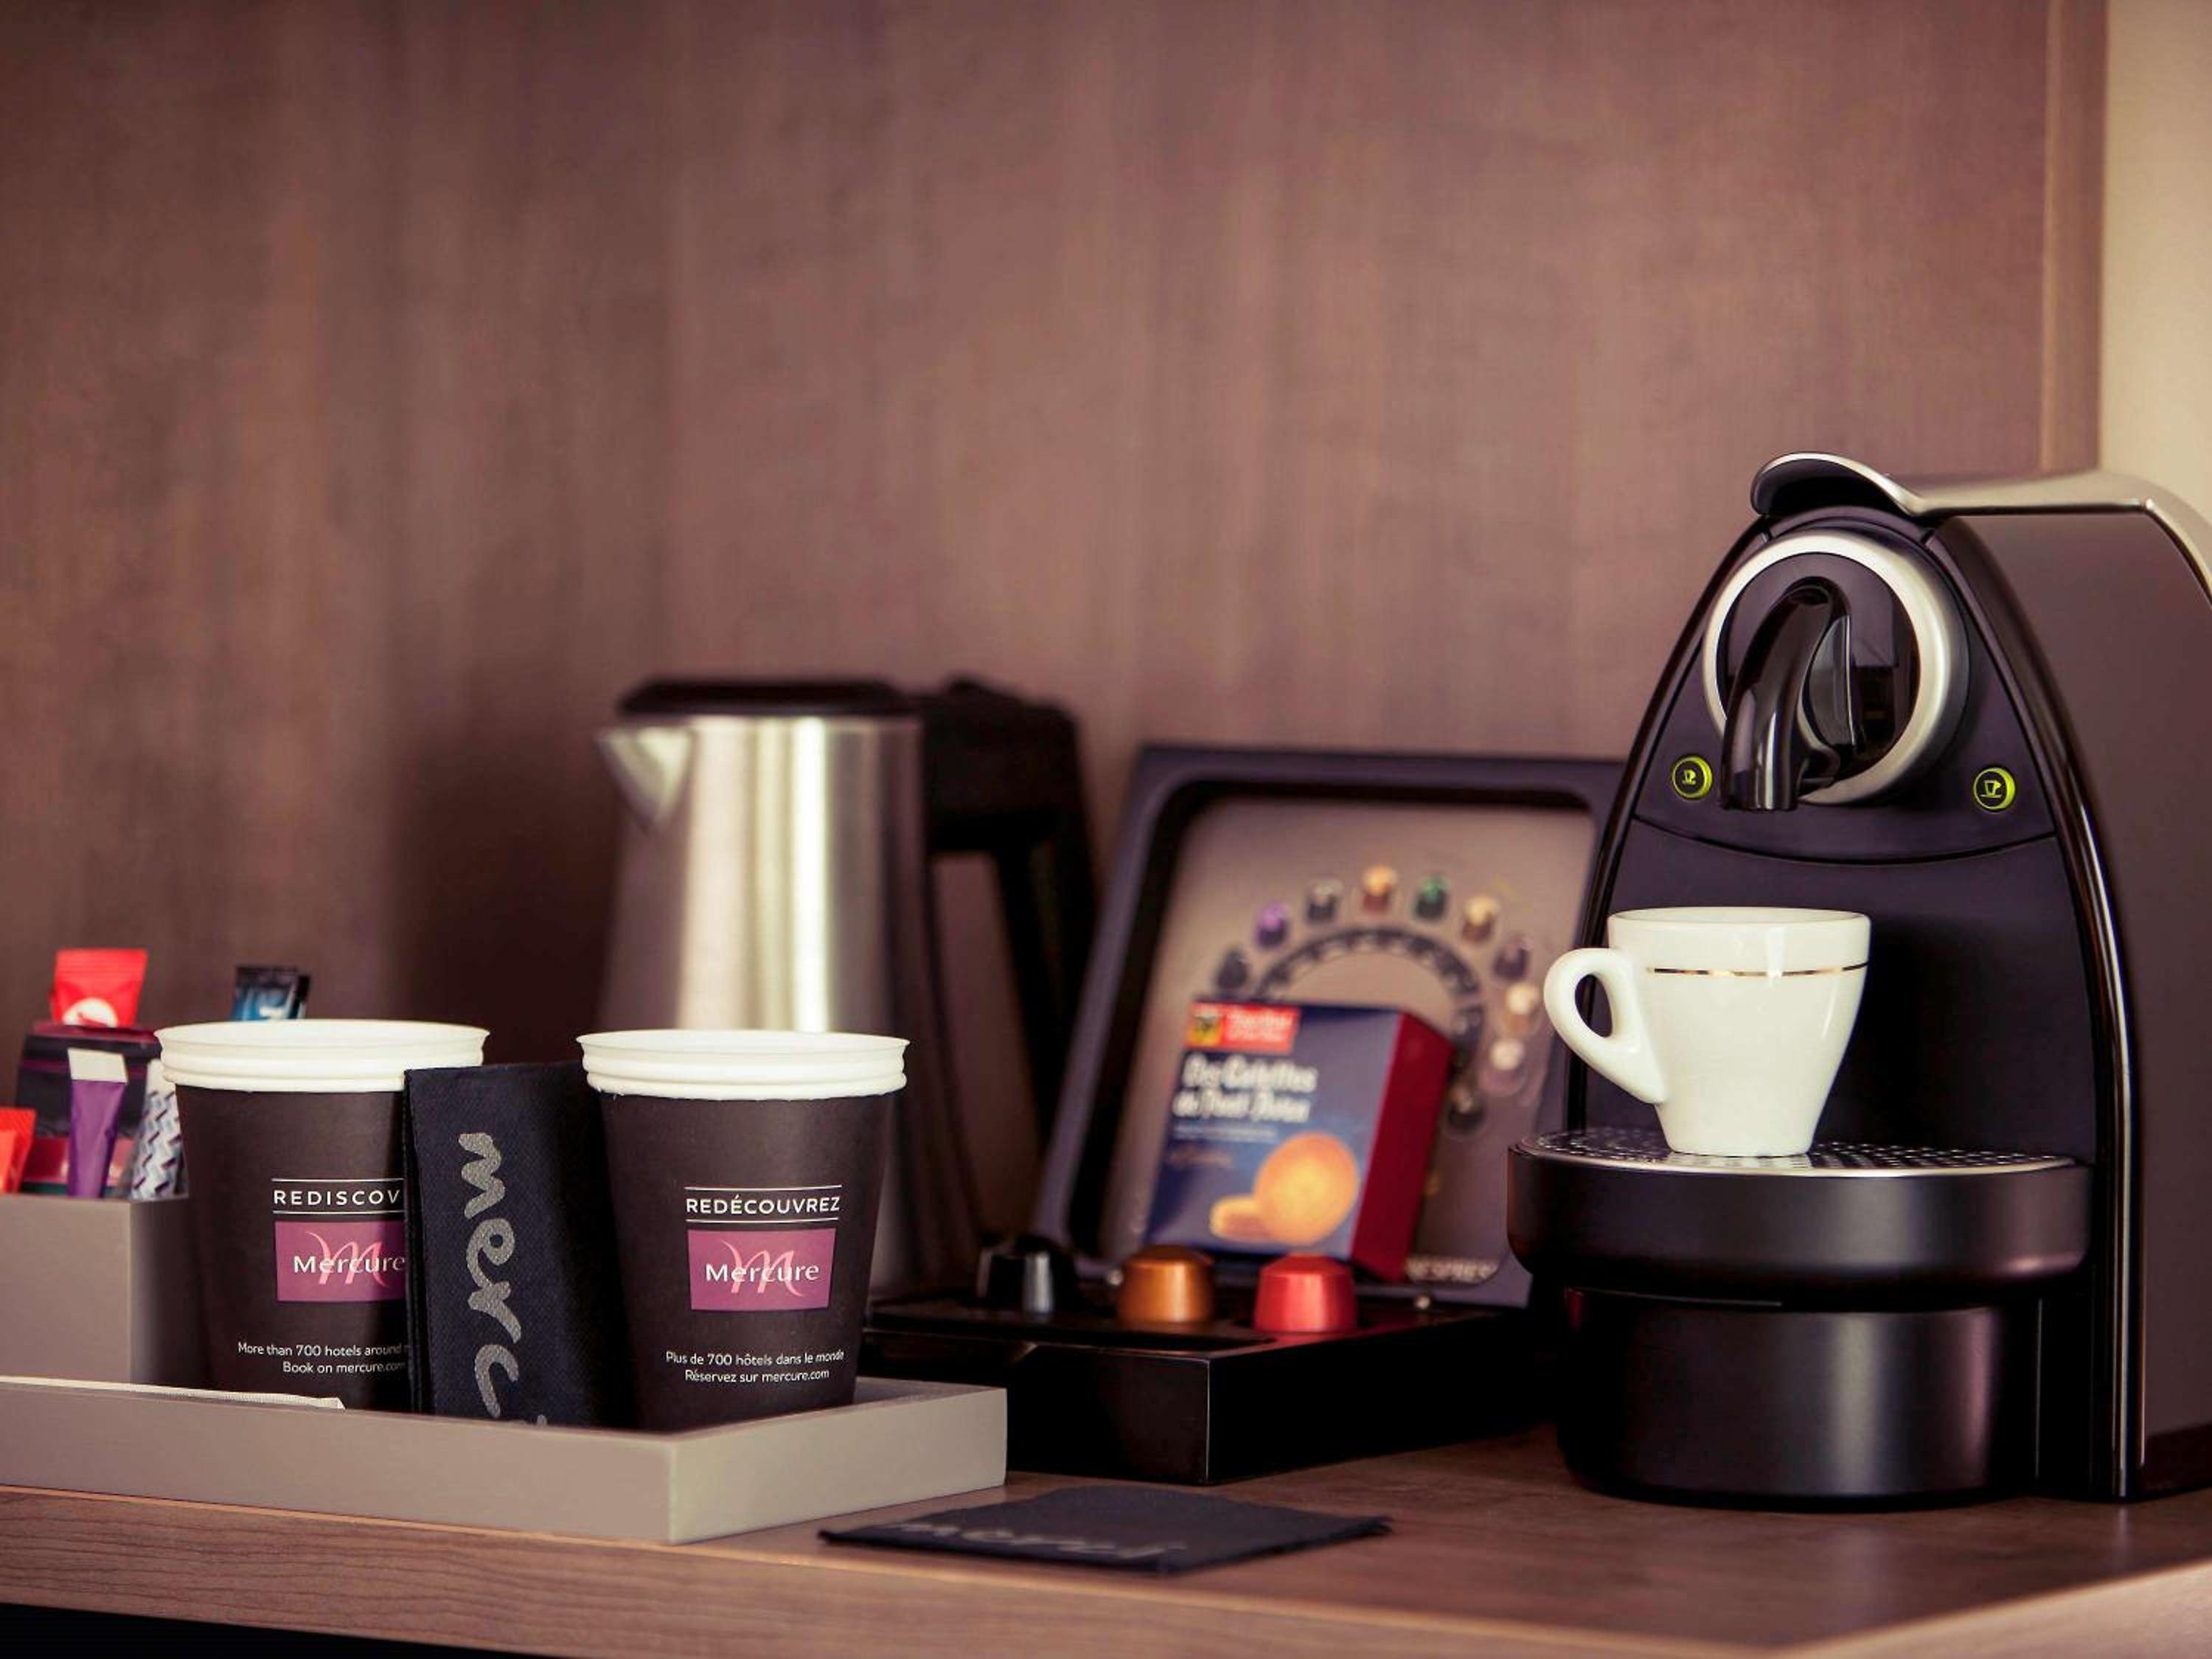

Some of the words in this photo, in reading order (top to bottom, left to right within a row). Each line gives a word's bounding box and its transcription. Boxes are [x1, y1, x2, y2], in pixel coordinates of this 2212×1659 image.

[274, 1189, 400, 1206] REDISCOV
[686, 1194, 841, 1214] REDÉCOUVREZ
[293, 1255, 406, 1273] Mercure
[459, 1133, 547, 1426] merc
[705, 1263, 820, 1283] Mercure
[237, 1342, 265, 1354] More
[266, 1344, 293, 1357] than
[296, 1344, 321, 1357] 700
[324, 1344, 362, 1357] hotels
[365, 1343, 402, 1356] around
[666, 1351, 688, 1364] Plus
[690, 1353, 704, 1365] de
[707, 1354, 733, 1366] 700
[735, 1353, 773, 1366] hôtels
[776, 1353, 802, 1366] dans
[804, 1352, 813, 1363] le
[815, 1349, 844, 1363] monde
[282, 1361, 314, 1374] Book
[317, 1363, 333, 1374] on
[685, 1368, 737, 1382] Réservez
[740, 1372, 759, 1382] sur
[762, 1368, 830, 1383] mercure.com
